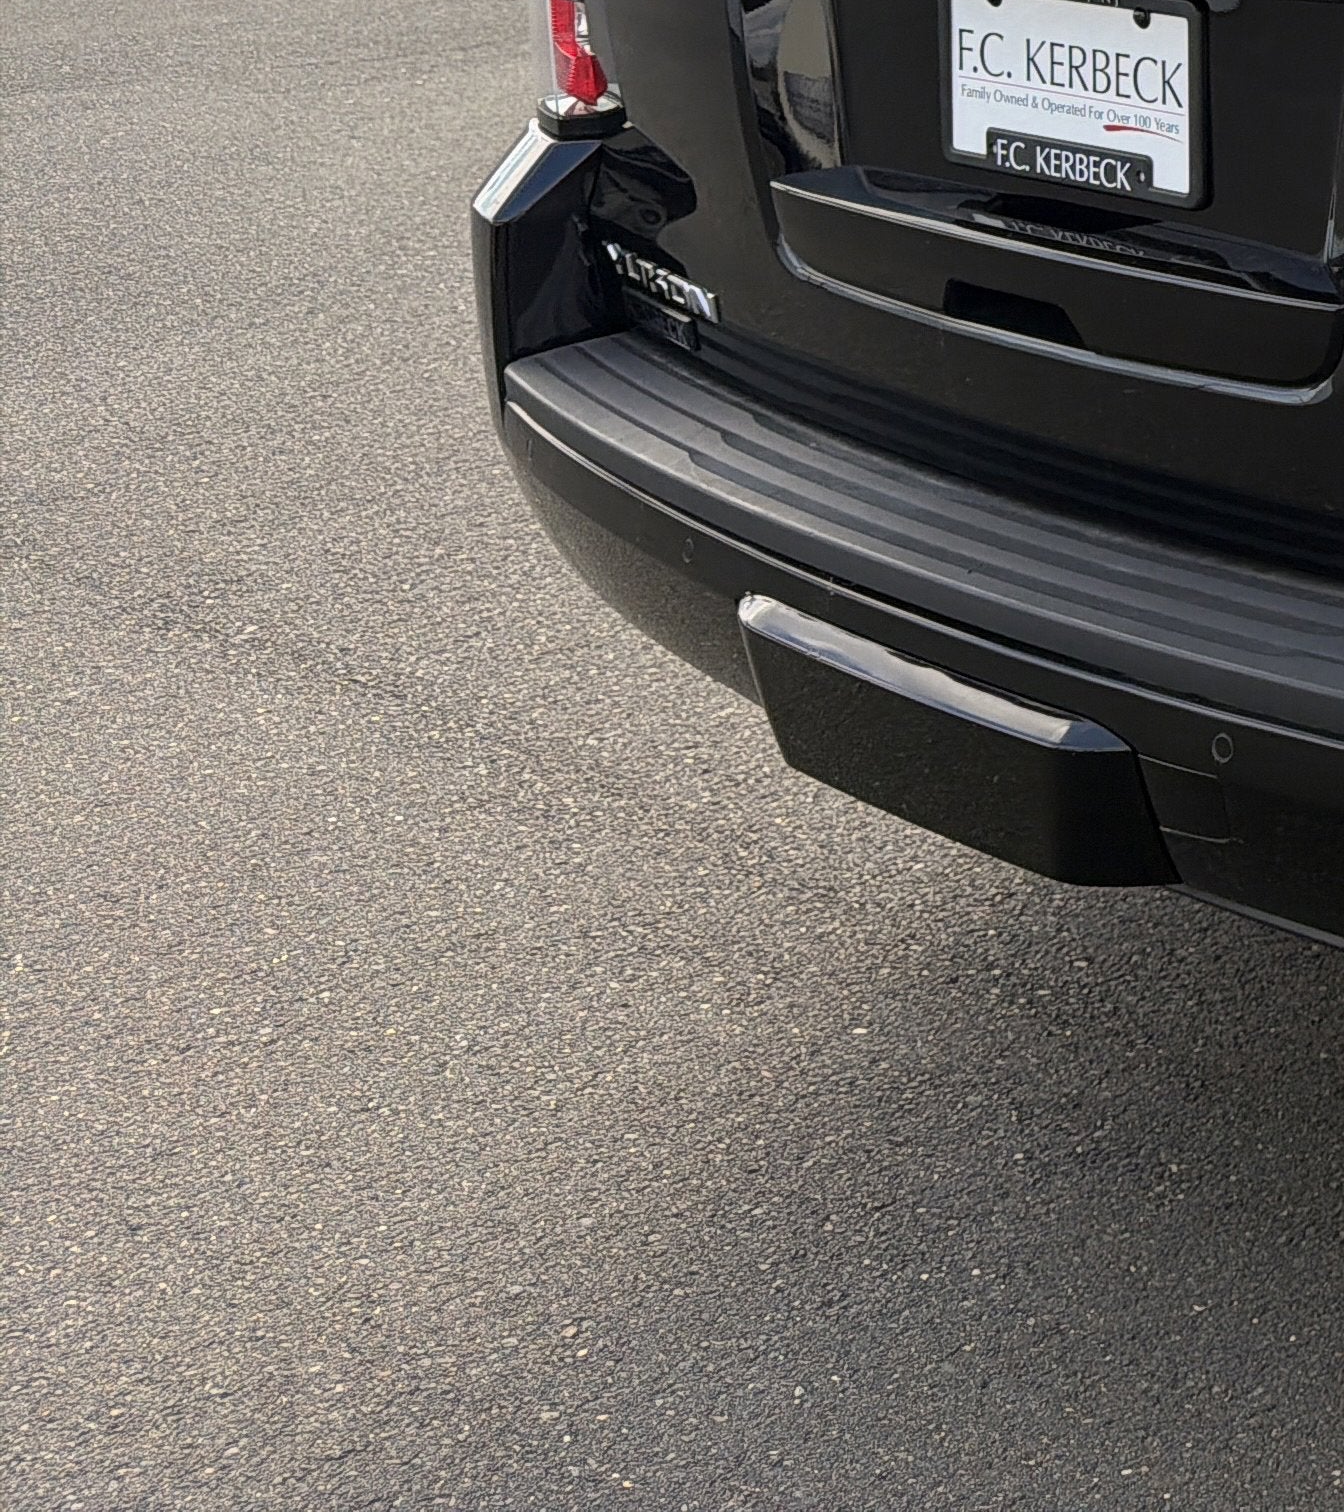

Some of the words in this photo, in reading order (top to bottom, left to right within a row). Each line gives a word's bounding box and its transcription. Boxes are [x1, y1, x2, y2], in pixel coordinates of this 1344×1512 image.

[958, 28, 1012, 79] F.C.
[1025, 38, 1184, 109] KERBECK
[961, 84, 991, 104] Family
[993, 88, 1029, 108] Owned
[1031, 95, 1039, 109] &
[1041, 97, 1087, 118] Operated
[1089, 105, 1105, 121] For
[1107, 109, 1131, 125] Over
[1134, 113, 1152, 129] 100
[1154, 117, 1180, 135] Years
[996, 138, 1031, 172] F.C.
[1035, 145, 1132, 192] KERBECK
